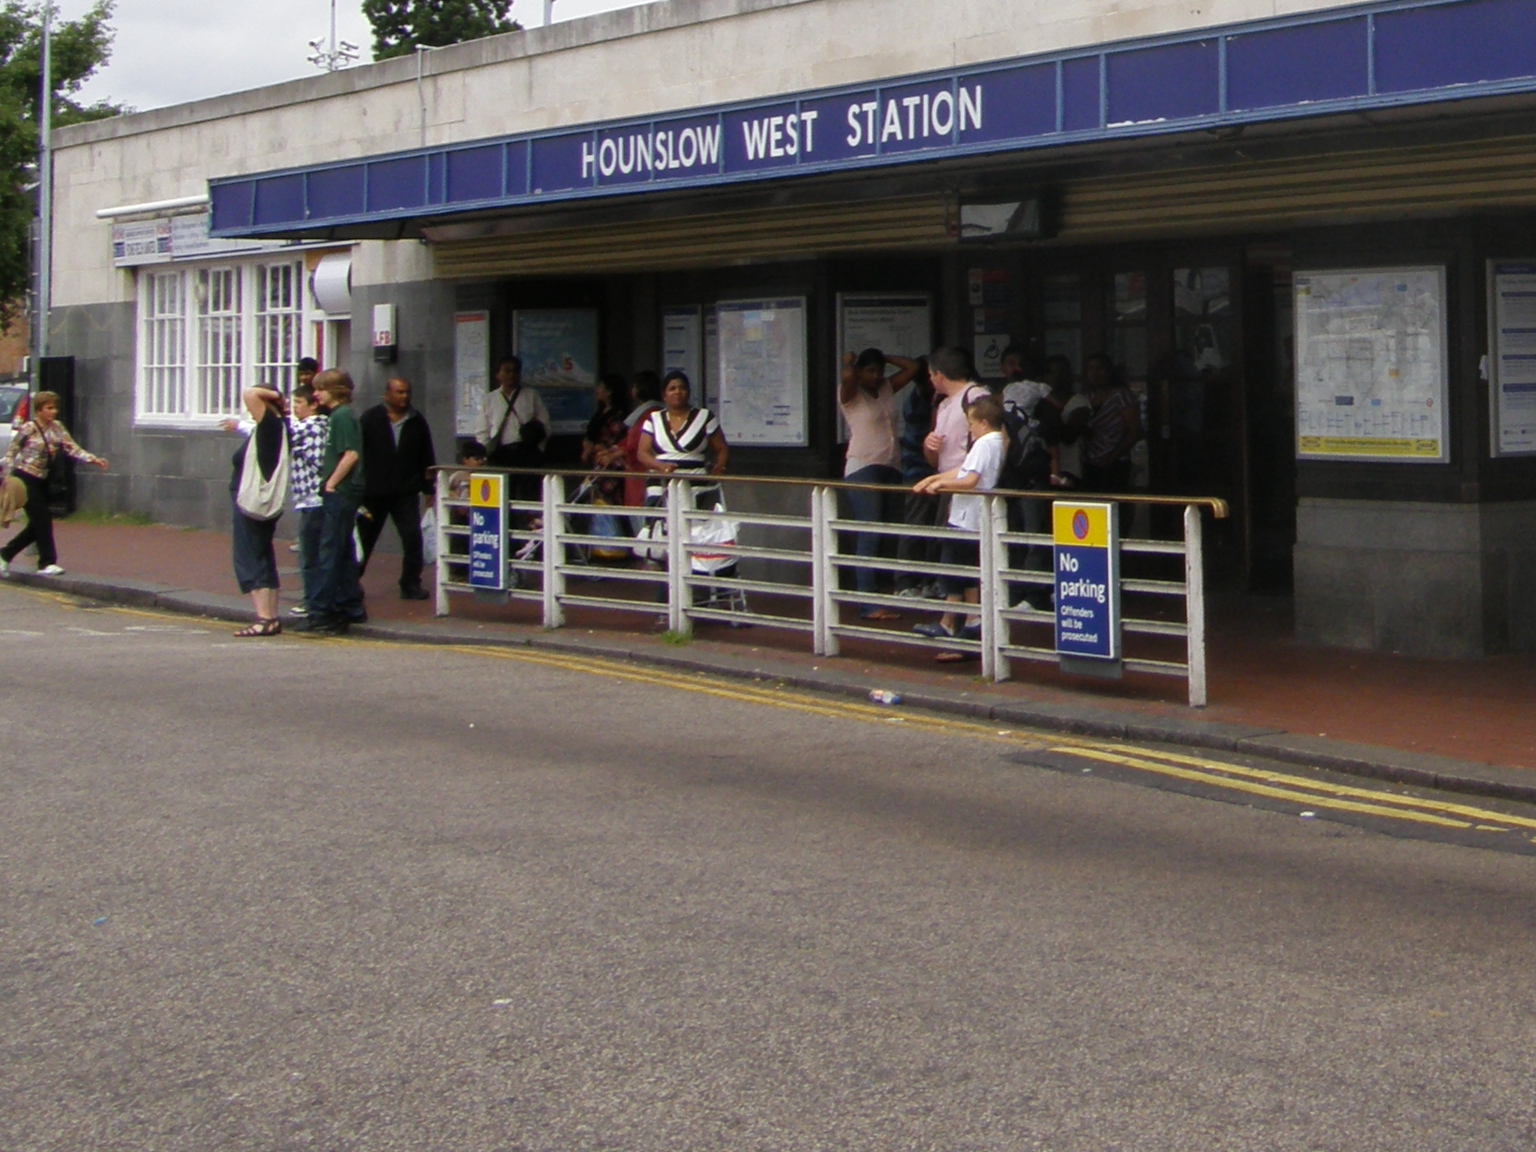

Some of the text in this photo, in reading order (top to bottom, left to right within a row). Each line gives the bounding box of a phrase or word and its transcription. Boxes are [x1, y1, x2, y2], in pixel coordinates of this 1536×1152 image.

[581, 85, 982, 179] HOUNSLOW WEST STATION
[371, 330, 391, 346] LFB
[473, 512, 484, 526] No
[473, 531, 499, 549] parking
[1059, 552, 1079, 573] No
[1060, 577, 1106, 604] parking
[1061, 605, 1094, 618] Offenders
[1061, 618, 1083, 630] will be
[1061, 632, 1098, 643] prosecuted
